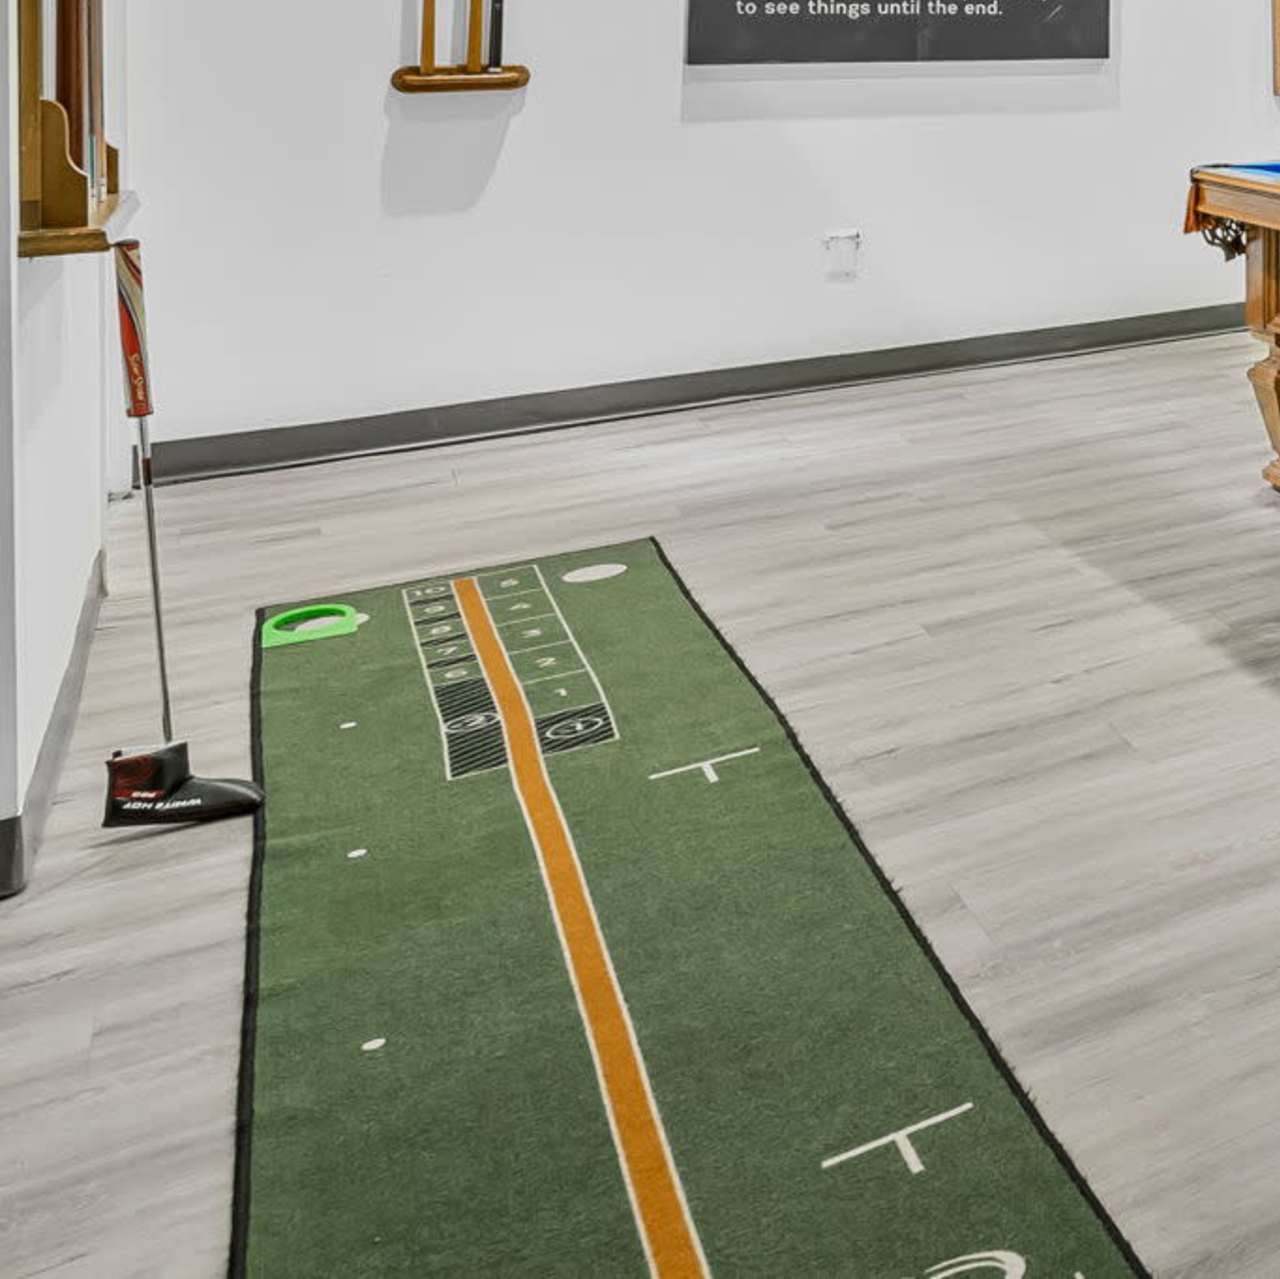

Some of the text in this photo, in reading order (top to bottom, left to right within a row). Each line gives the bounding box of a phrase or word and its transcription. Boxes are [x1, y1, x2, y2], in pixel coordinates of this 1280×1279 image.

[736, 0, 757, 15] to
[764, 2, 800, 15] see
[877, 0, 921, 15] until
[927, 0, 959, 15] the
[964, 0, 1004, 15] end.
